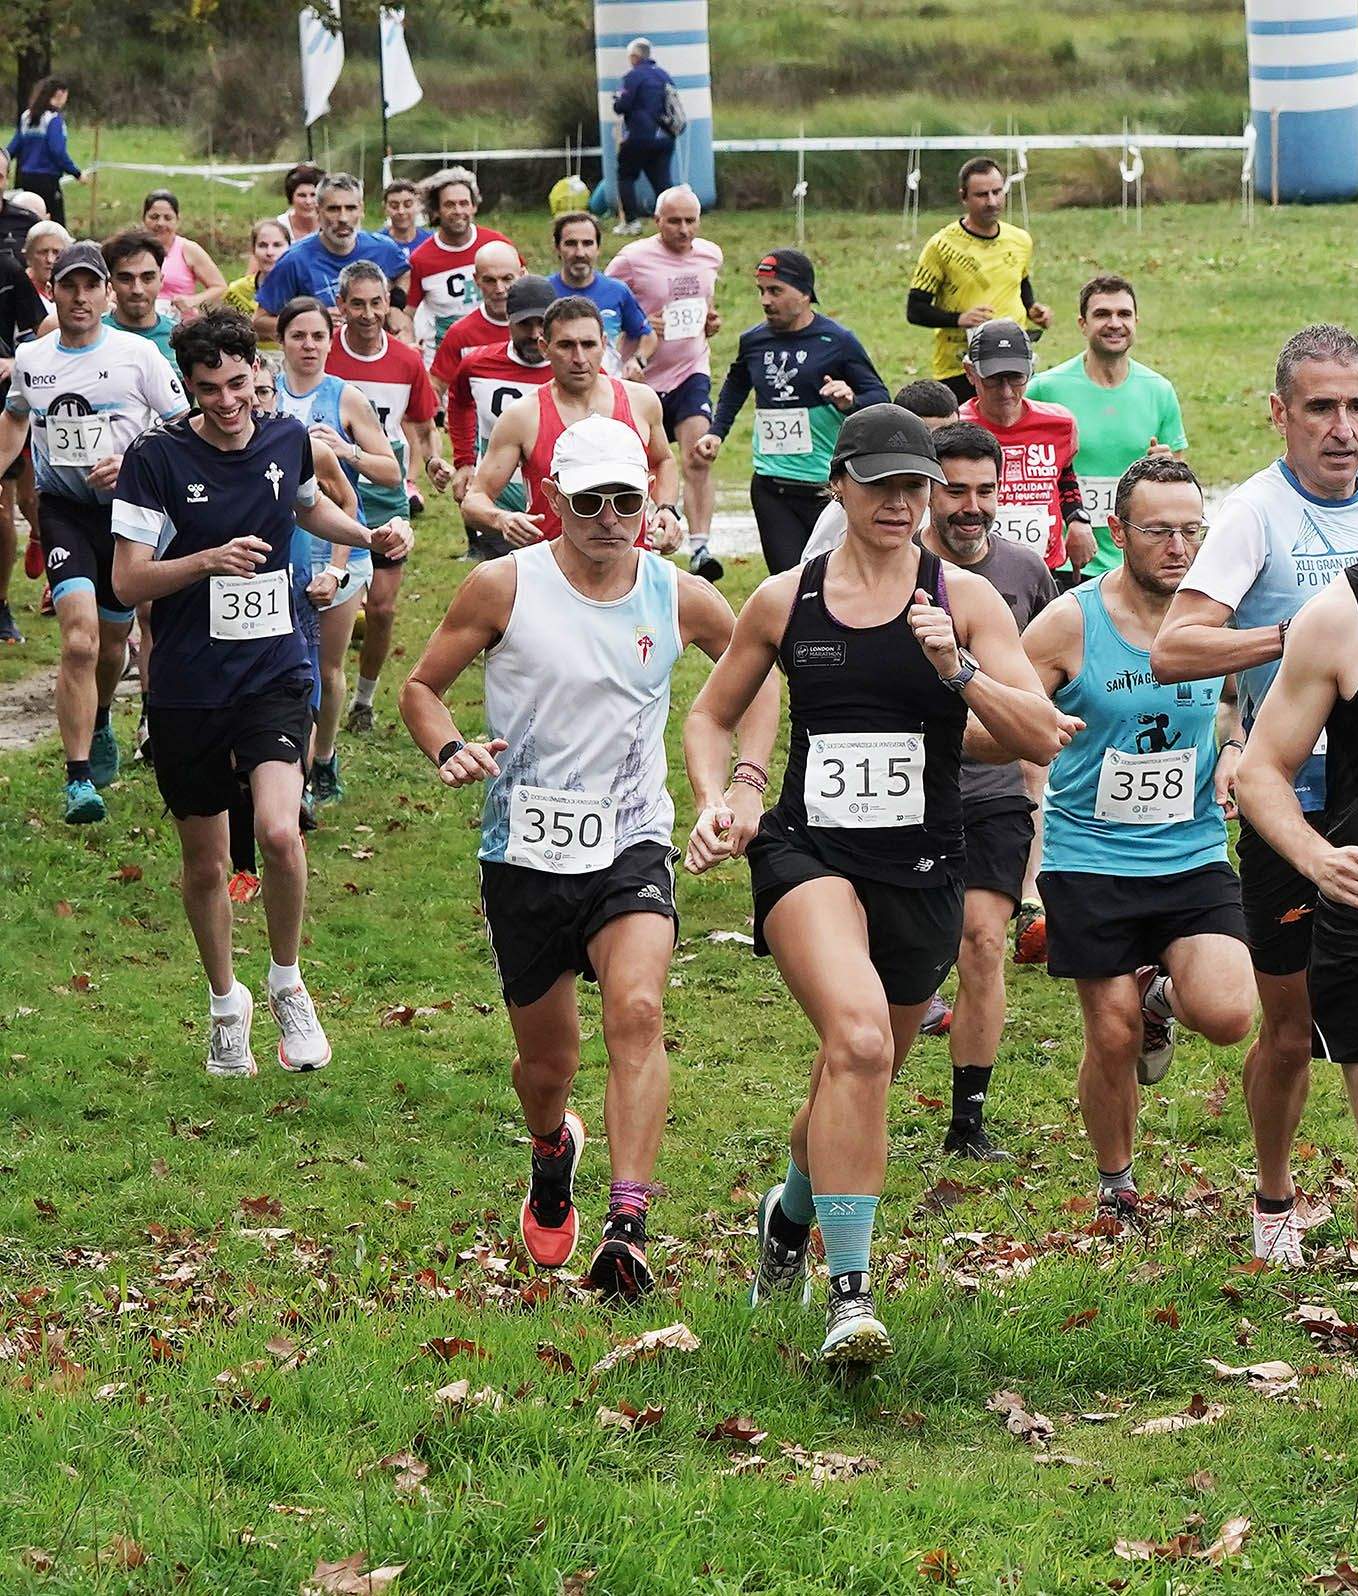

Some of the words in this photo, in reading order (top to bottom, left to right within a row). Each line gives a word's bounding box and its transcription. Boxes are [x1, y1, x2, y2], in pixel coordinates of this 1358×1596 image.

[32, 373, 57, 385] ence
[55, 427, 103, 450] 317
[762, 420, 804, 441] 334
[1026, 443, 1057, 466] SU
[1026, 465, 1058, 477] man
[1084, 489, 1114, 511] 31
[1316, 558, 1343, 571] GRAN
[222, 588, 280, 620] 381
[820, 757, 912, 799] 315
[1111, 768, 1184, 801] 358
[522, 807, 603, 848] 350
